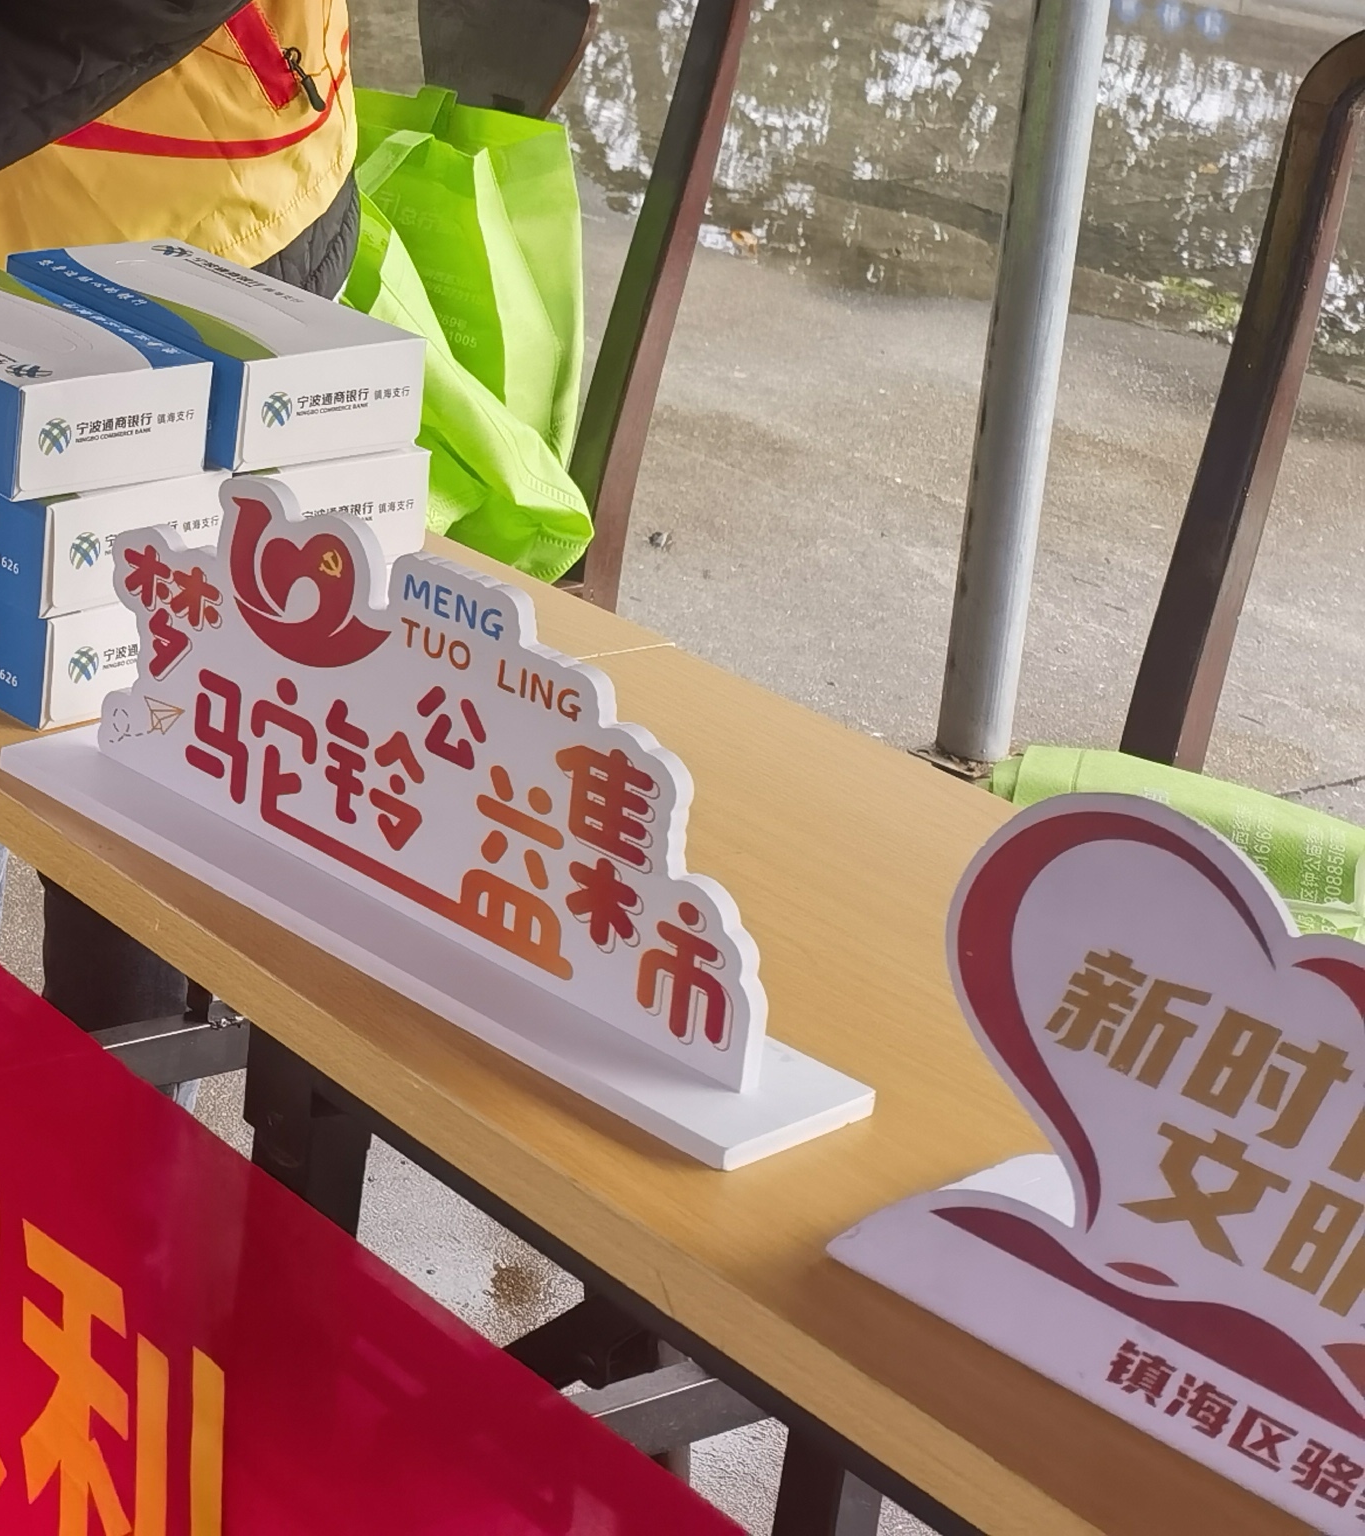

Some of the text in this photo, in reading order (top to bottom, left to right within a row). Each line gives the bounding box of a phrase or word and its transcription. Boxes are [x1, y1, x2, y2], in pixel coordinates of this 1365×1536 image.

[297, 385, 411, 408] 宁波通商银行 镇海支行
[75, 409, 196, 436] 宁波通商银行 镇海支行
[296, 402, 369, 418] NINGBO COMMERCE BANK
[75, 426, 152, 444] NINGBO COMMERCE BANK
[378, 498, 415, 514] 镇海支行
[182, 515, 220, 533] 镇海支行
[402, 573, 504, 642] MENG
[400, 616, 583, 722] TUO LING
[1044, 948, 1365, 1182] 新时
[1105, 1338, 1365, 1519] 镇海区骆
